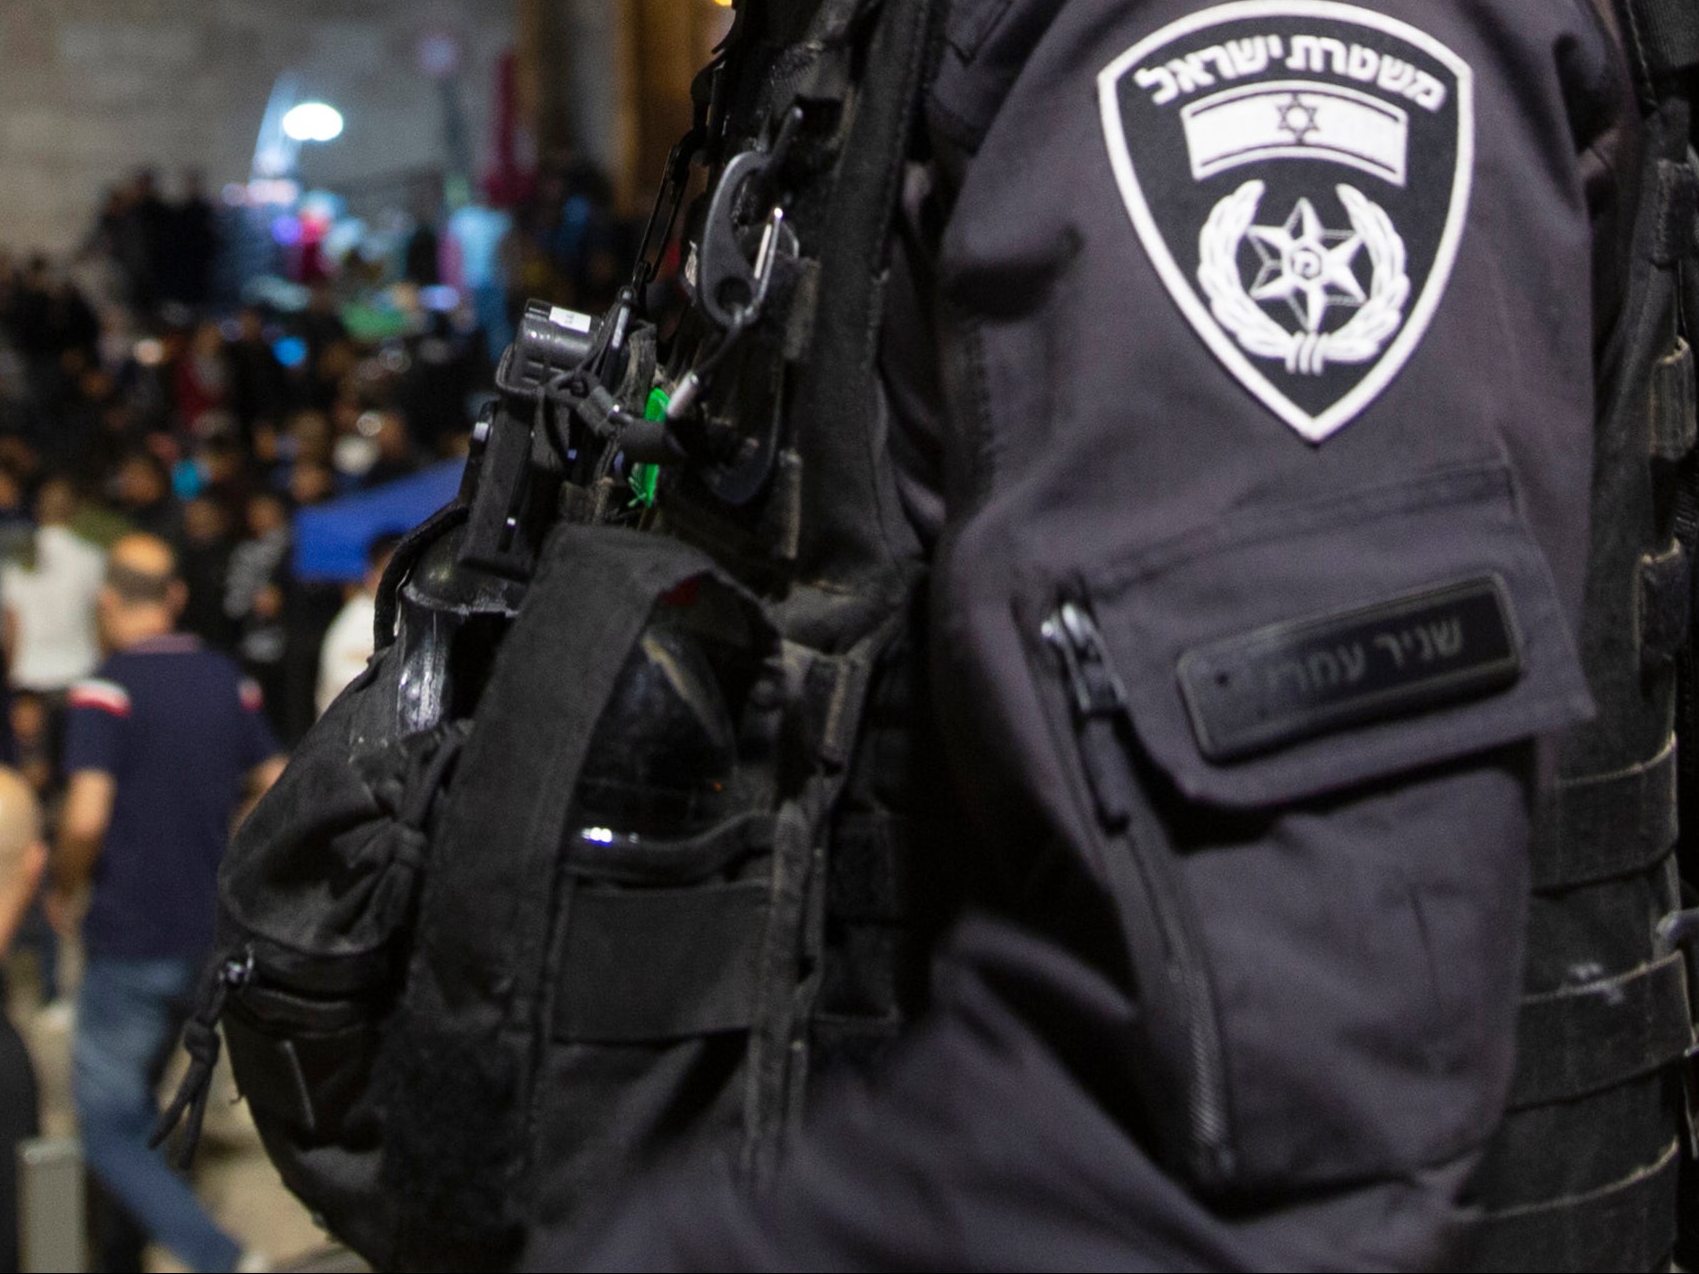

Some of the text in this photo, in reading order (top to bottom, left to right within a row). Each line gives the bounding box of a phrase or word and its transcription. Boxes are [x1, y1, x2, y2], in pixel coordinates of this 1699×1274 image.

[1133, 33, 1448, 113] משטרת ישראל
[1372, 616, 1465, 669] שניר
